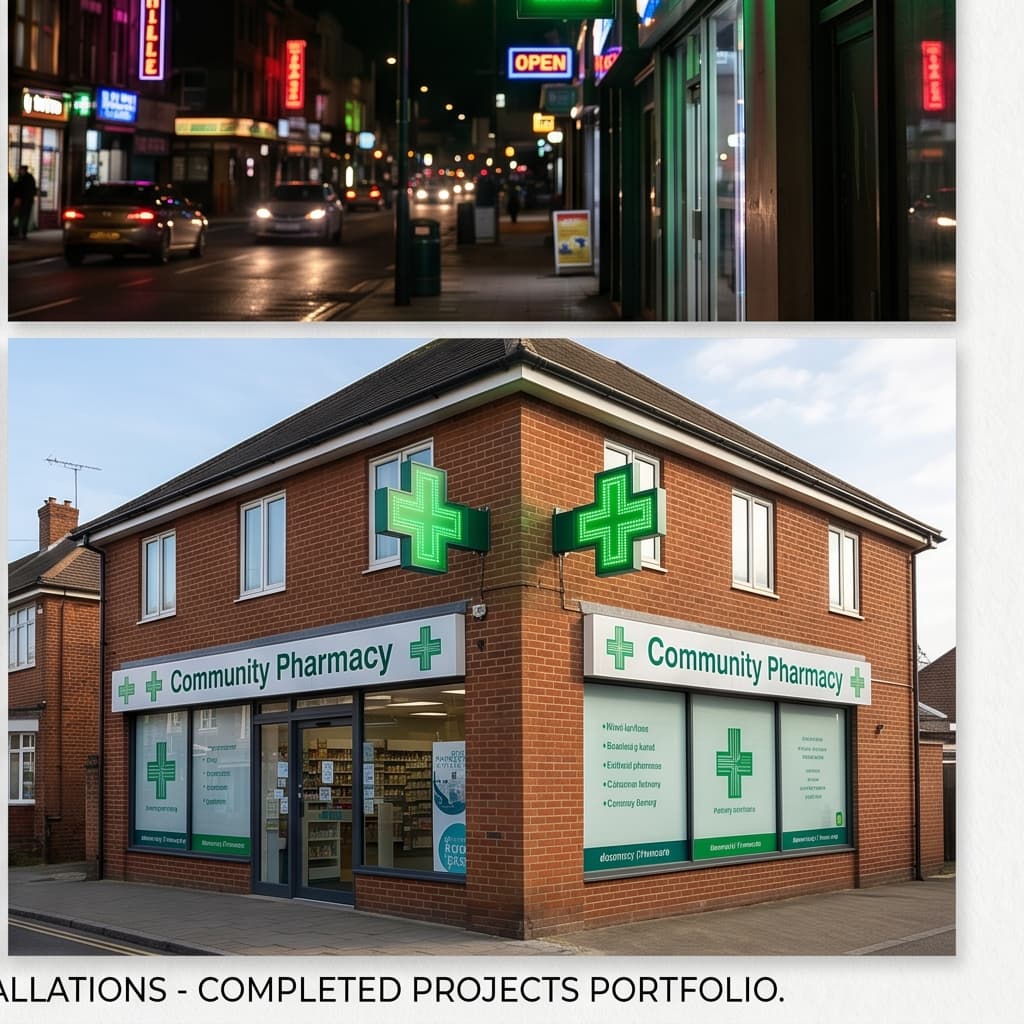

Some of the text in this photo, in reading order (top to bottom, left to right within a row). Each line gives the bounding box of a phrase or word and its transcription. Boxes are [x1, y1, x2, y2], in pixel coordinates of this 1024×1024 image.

[515, 54, 567, 72] OPEN
[171, 643, 393, 690] Community Pharmacy
[648, 636, 843, 696] Community Pharmacy
